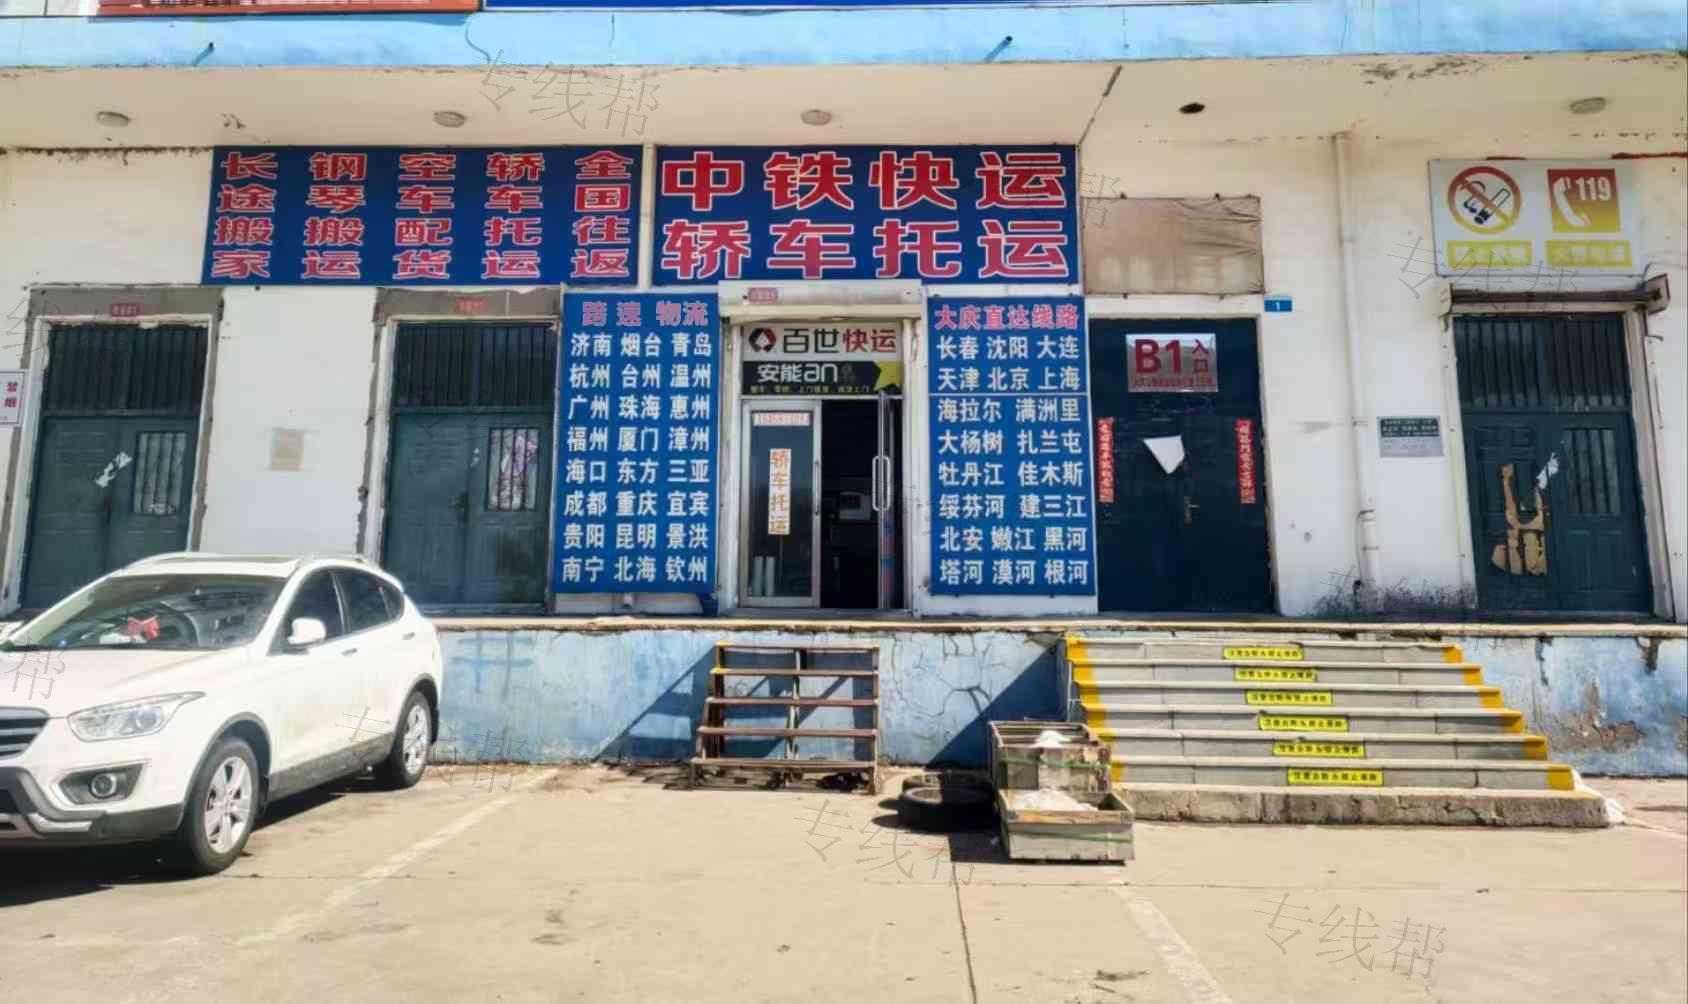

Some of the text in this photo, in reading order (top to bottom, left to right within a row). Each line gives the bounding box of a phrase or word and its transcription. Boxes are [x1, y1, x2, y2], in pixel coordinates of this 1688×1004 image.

[661, 151, 1067, 211] 中铁快运
[1575, 176, 1612, 201] 119
[211, 152, 278, 279] 长途搬家
[301, 152, 368, 279] 钢琴搬运
[392, 152, 456, 280] 空车配货
[481, 152, 545, 279] 轿车托运
[571, 150, 634, 278] 全国往返
[661, 219, 1069, 279] 轿车托运
[656, 301, 708, 326] 物流
[935, 304, 1078, 330] 大庆直达线路
[571, 333, 711, 356] 济南 烟台 青岛
[783, 328, 897, 354] 百世快运
[937, 336, 1078, 359] 长春 沈阳 大连
[1135, 339, 1210, 374] B1 入口
[570, 364, 711, 388] 杭州 台州 温州
[939, 366, 1079, 391] 天津 北京 上海
[569, 395, 709, 419] 广州 珠海 惠州
[939, 398, 1080, 422] 海拉尔 满洲里
[568, 427, 709, 451] 福州 厦门 漳州
[939, 430, 1081, 454] 大杨树 扎兰屯
[566, 458, 709, 483] 海口 东方 三亚
[939, 462, 1082, 486] 牡丹江 佳木斯
[565, 491, 708, 516] 成都 重庆 宜宾
[940, 494, 1086, 519] 绥芬河 建三江
[564, 523, 707, 548] 贵阳 昆明 景洪
[941, 527, 1086, 551] 北安 嫩江 黑河
[563, 556, 706, 581] 南宁 北海 钦州
[941, 560, 1087, 584] 塔河 漠河 根河
